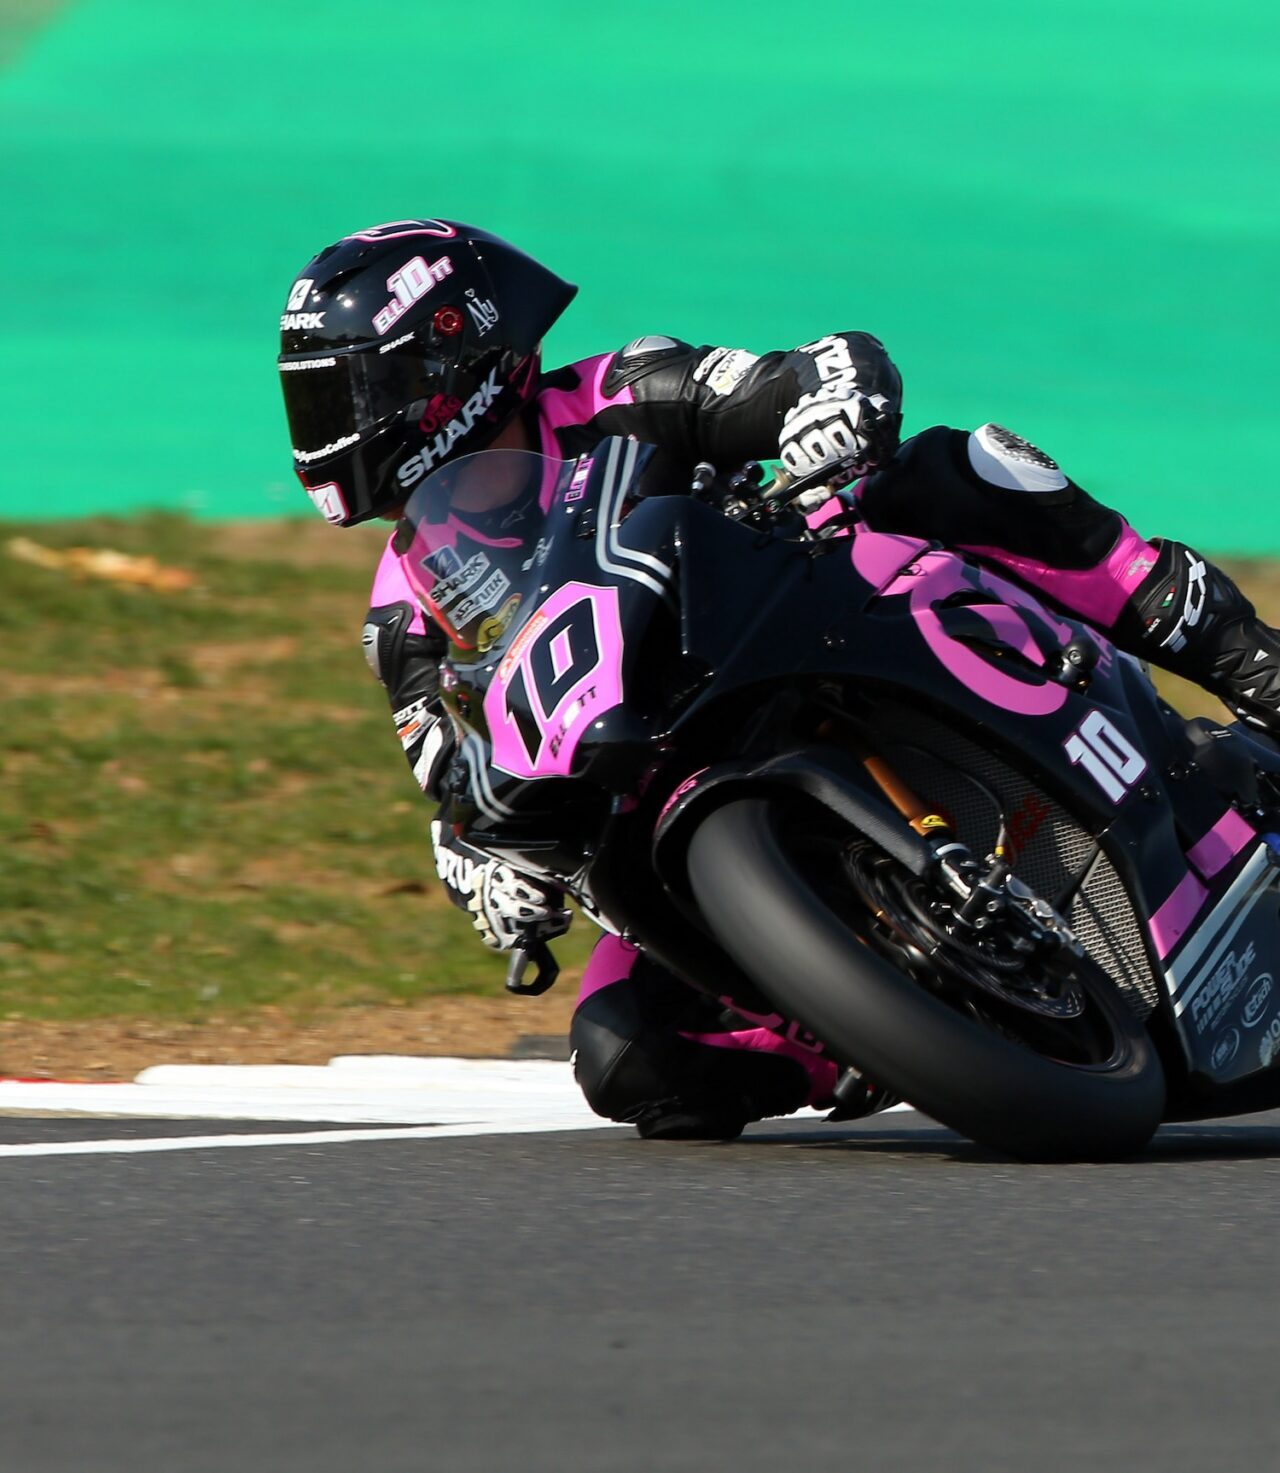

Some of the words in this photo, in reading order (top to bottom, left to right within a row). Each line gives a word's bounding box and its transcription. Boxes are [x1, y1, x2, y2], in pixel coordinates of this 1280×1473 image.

[379, 331, 416, 354] SHARK
[397, 366, 504, 488] SHARK
[431, 557, 484, 604] SHARK
[1160, 550, 1207, 654] TCX
[504, 595, 602, 769] 10
[1063, 709, 1148, 805] 10
